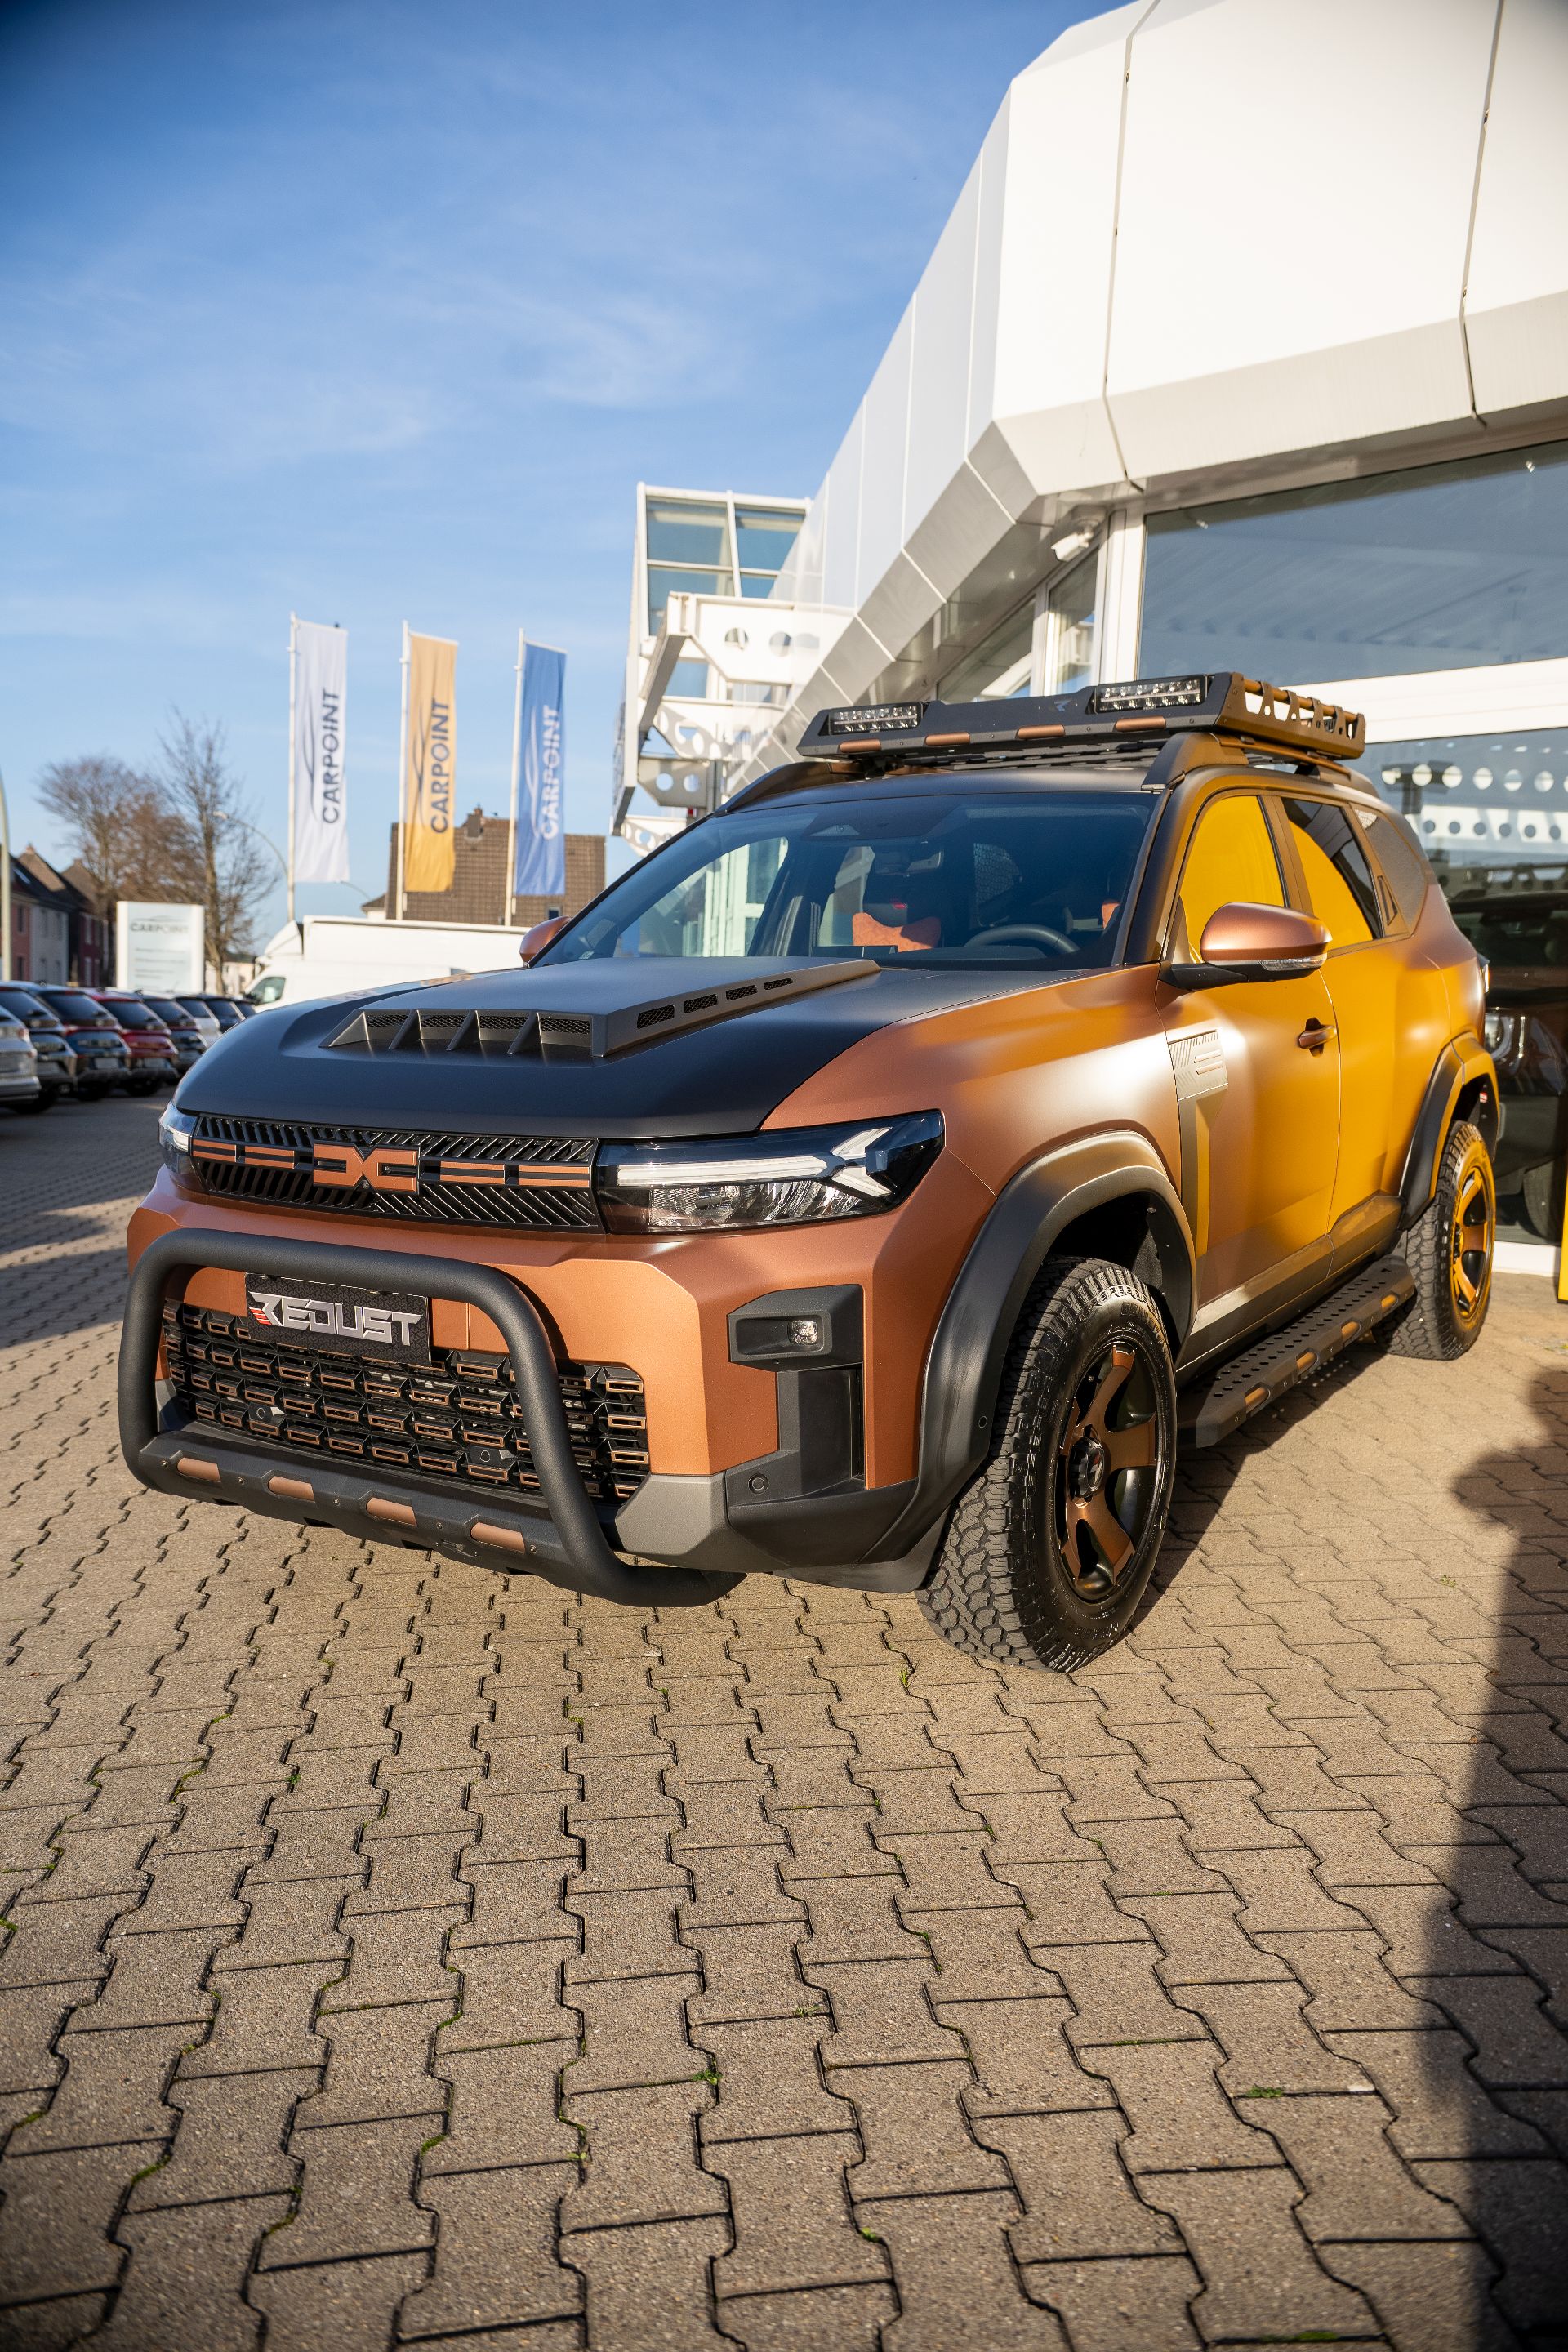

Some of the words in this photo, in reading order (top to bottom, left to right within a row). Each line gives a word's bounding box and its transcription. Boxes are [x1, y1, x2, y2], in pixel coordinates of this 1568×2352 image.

[323, 688, 340, 824] CARPOINT
[431, 698, 450, 833] CARPOINT
[542, 706, 560, 840] CARPOINT
[247, 1291, 422, 1346] REDUST
